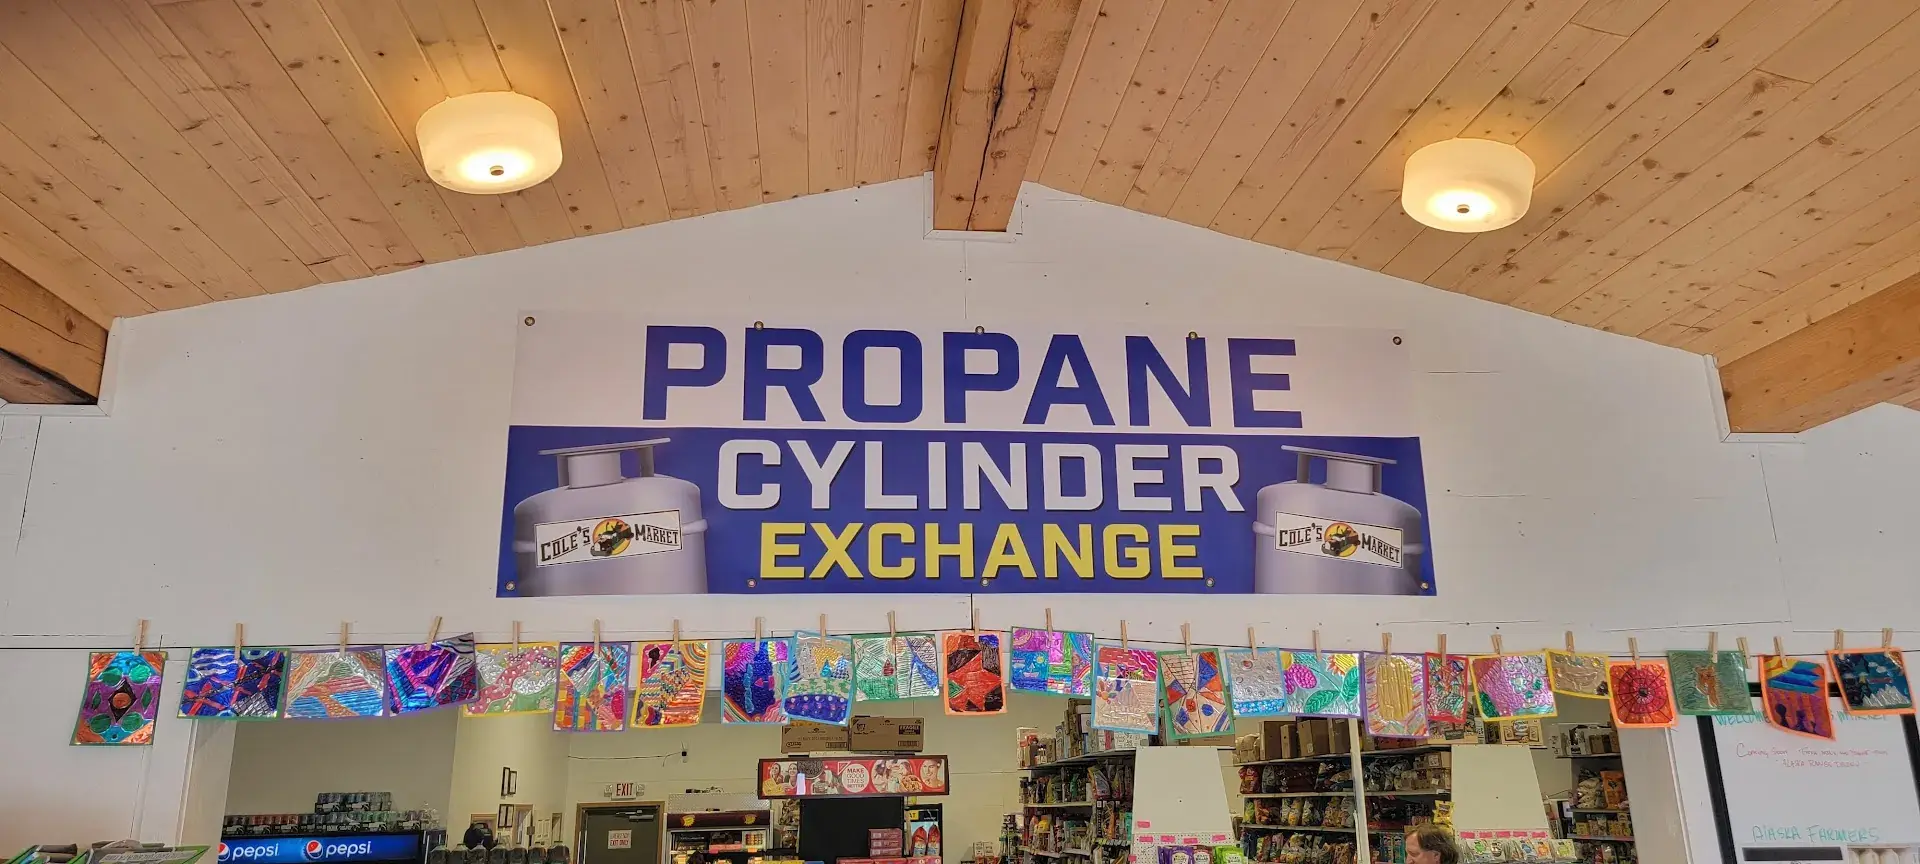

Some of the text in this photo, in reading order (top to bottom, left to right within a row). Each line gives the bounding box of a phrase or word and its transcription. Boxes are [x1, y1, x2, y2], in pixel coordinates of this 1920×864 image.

[643, 325, 1303, 428] PROPANE
[718, 439, 1244, 512] CYLINDER
[541, 523, 679, 561] COLE'S MARKET
[760, 522, 1204, 581] EXCHANGE
[1279, 522, 1400, 563] COLE'S MARKET
[616, 783, 634, 796] EXIT
[232, 843, 278, 860] pepsi
[325, 841, 371, 858] pepsi
[1807, 825, 1880, 843] FARMERS
